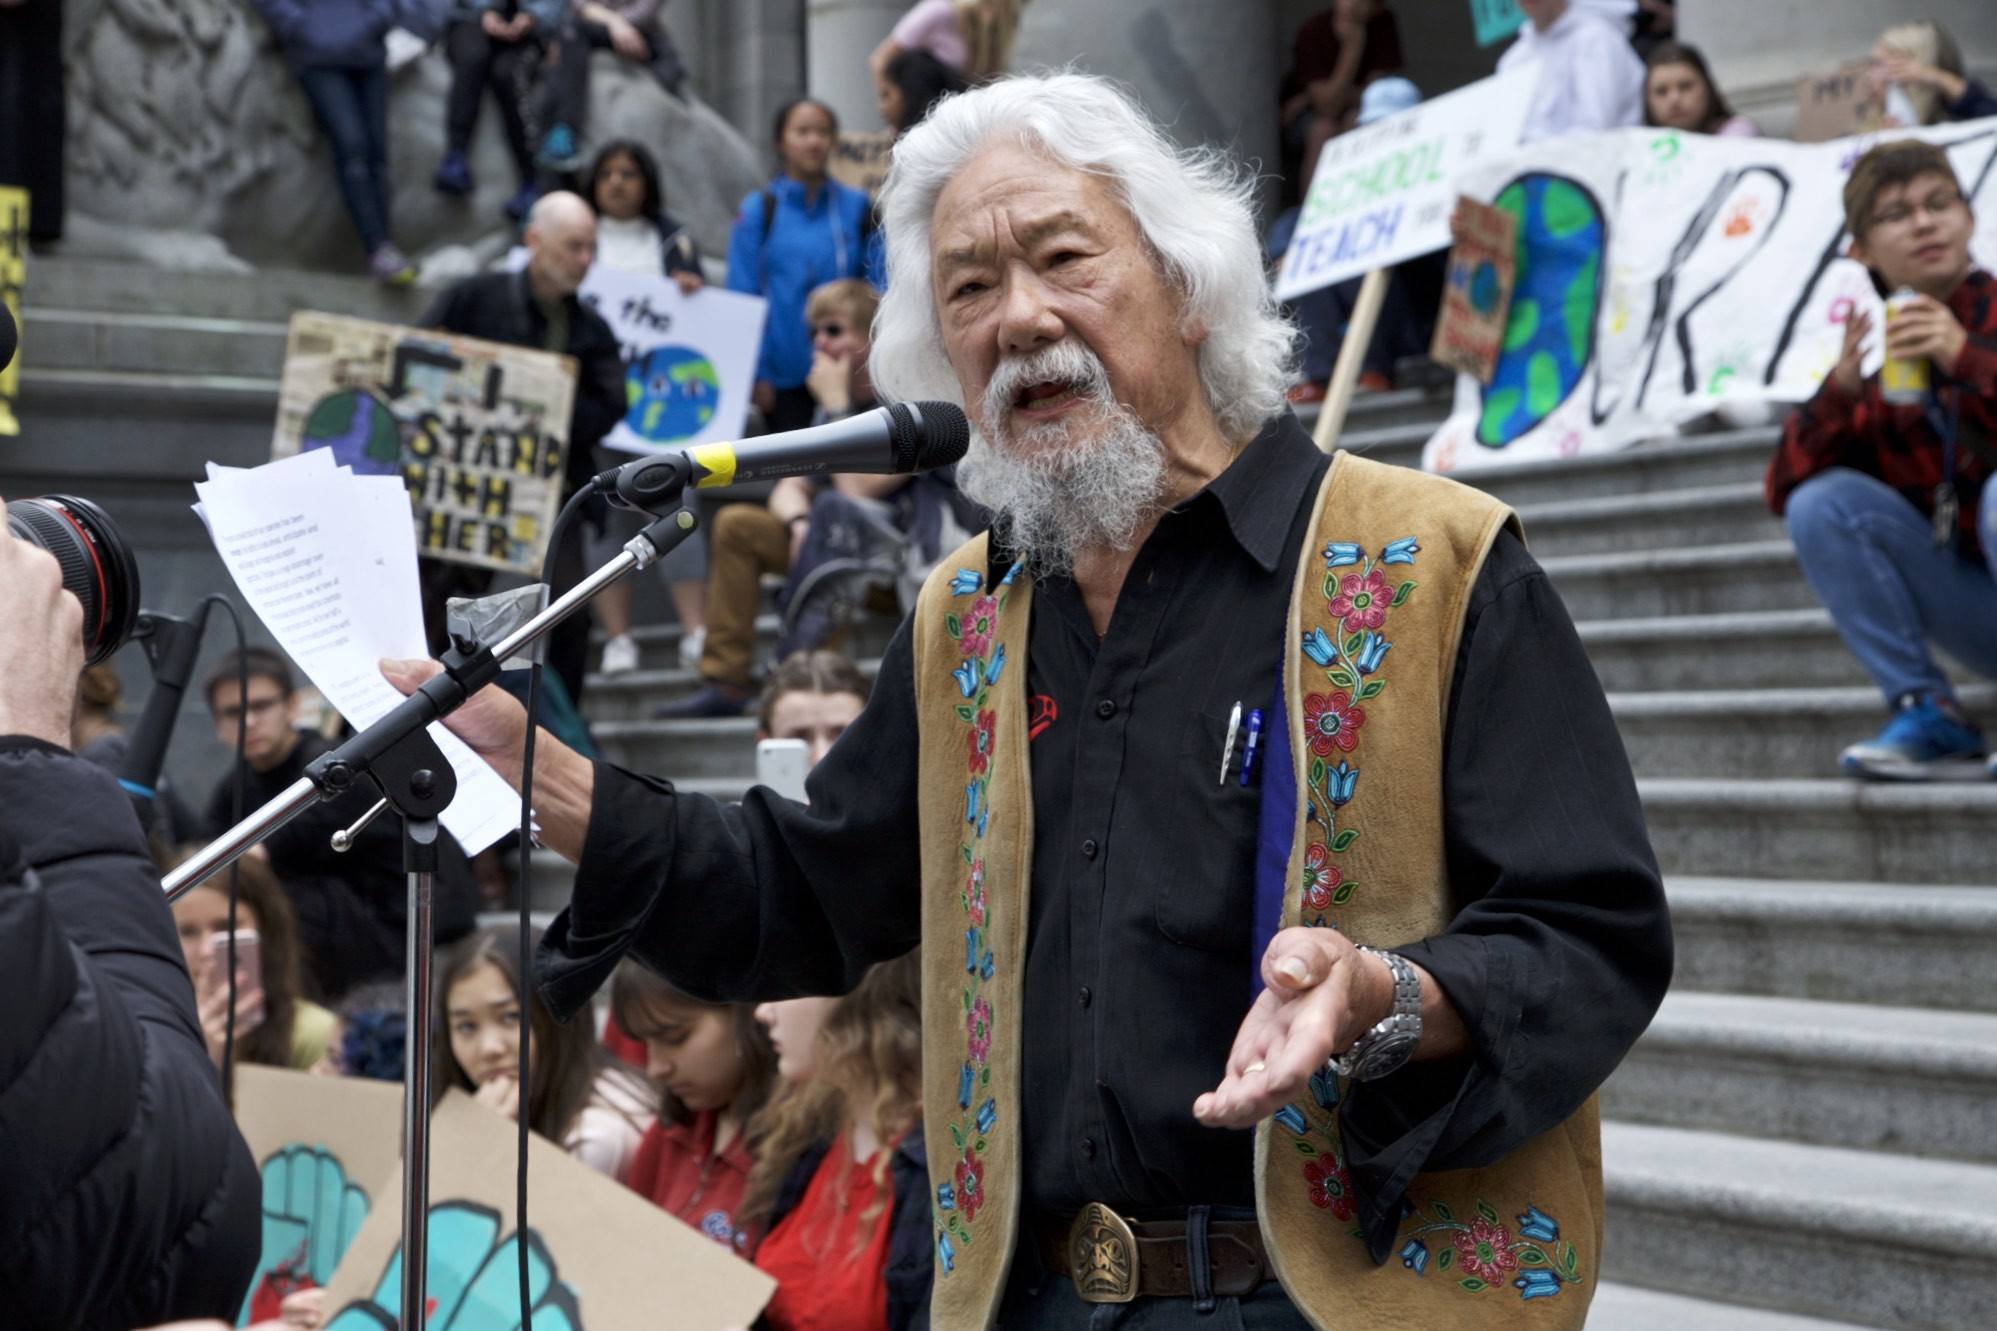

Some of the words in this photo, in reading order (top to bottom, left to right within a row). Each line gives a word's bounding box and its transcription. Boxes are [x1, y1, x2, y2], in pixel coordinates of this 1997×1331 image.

[1289, 201, 1404, 282] TEACH
[621, 296, 672, 334] the
[424, 511, 509, 559] HER
